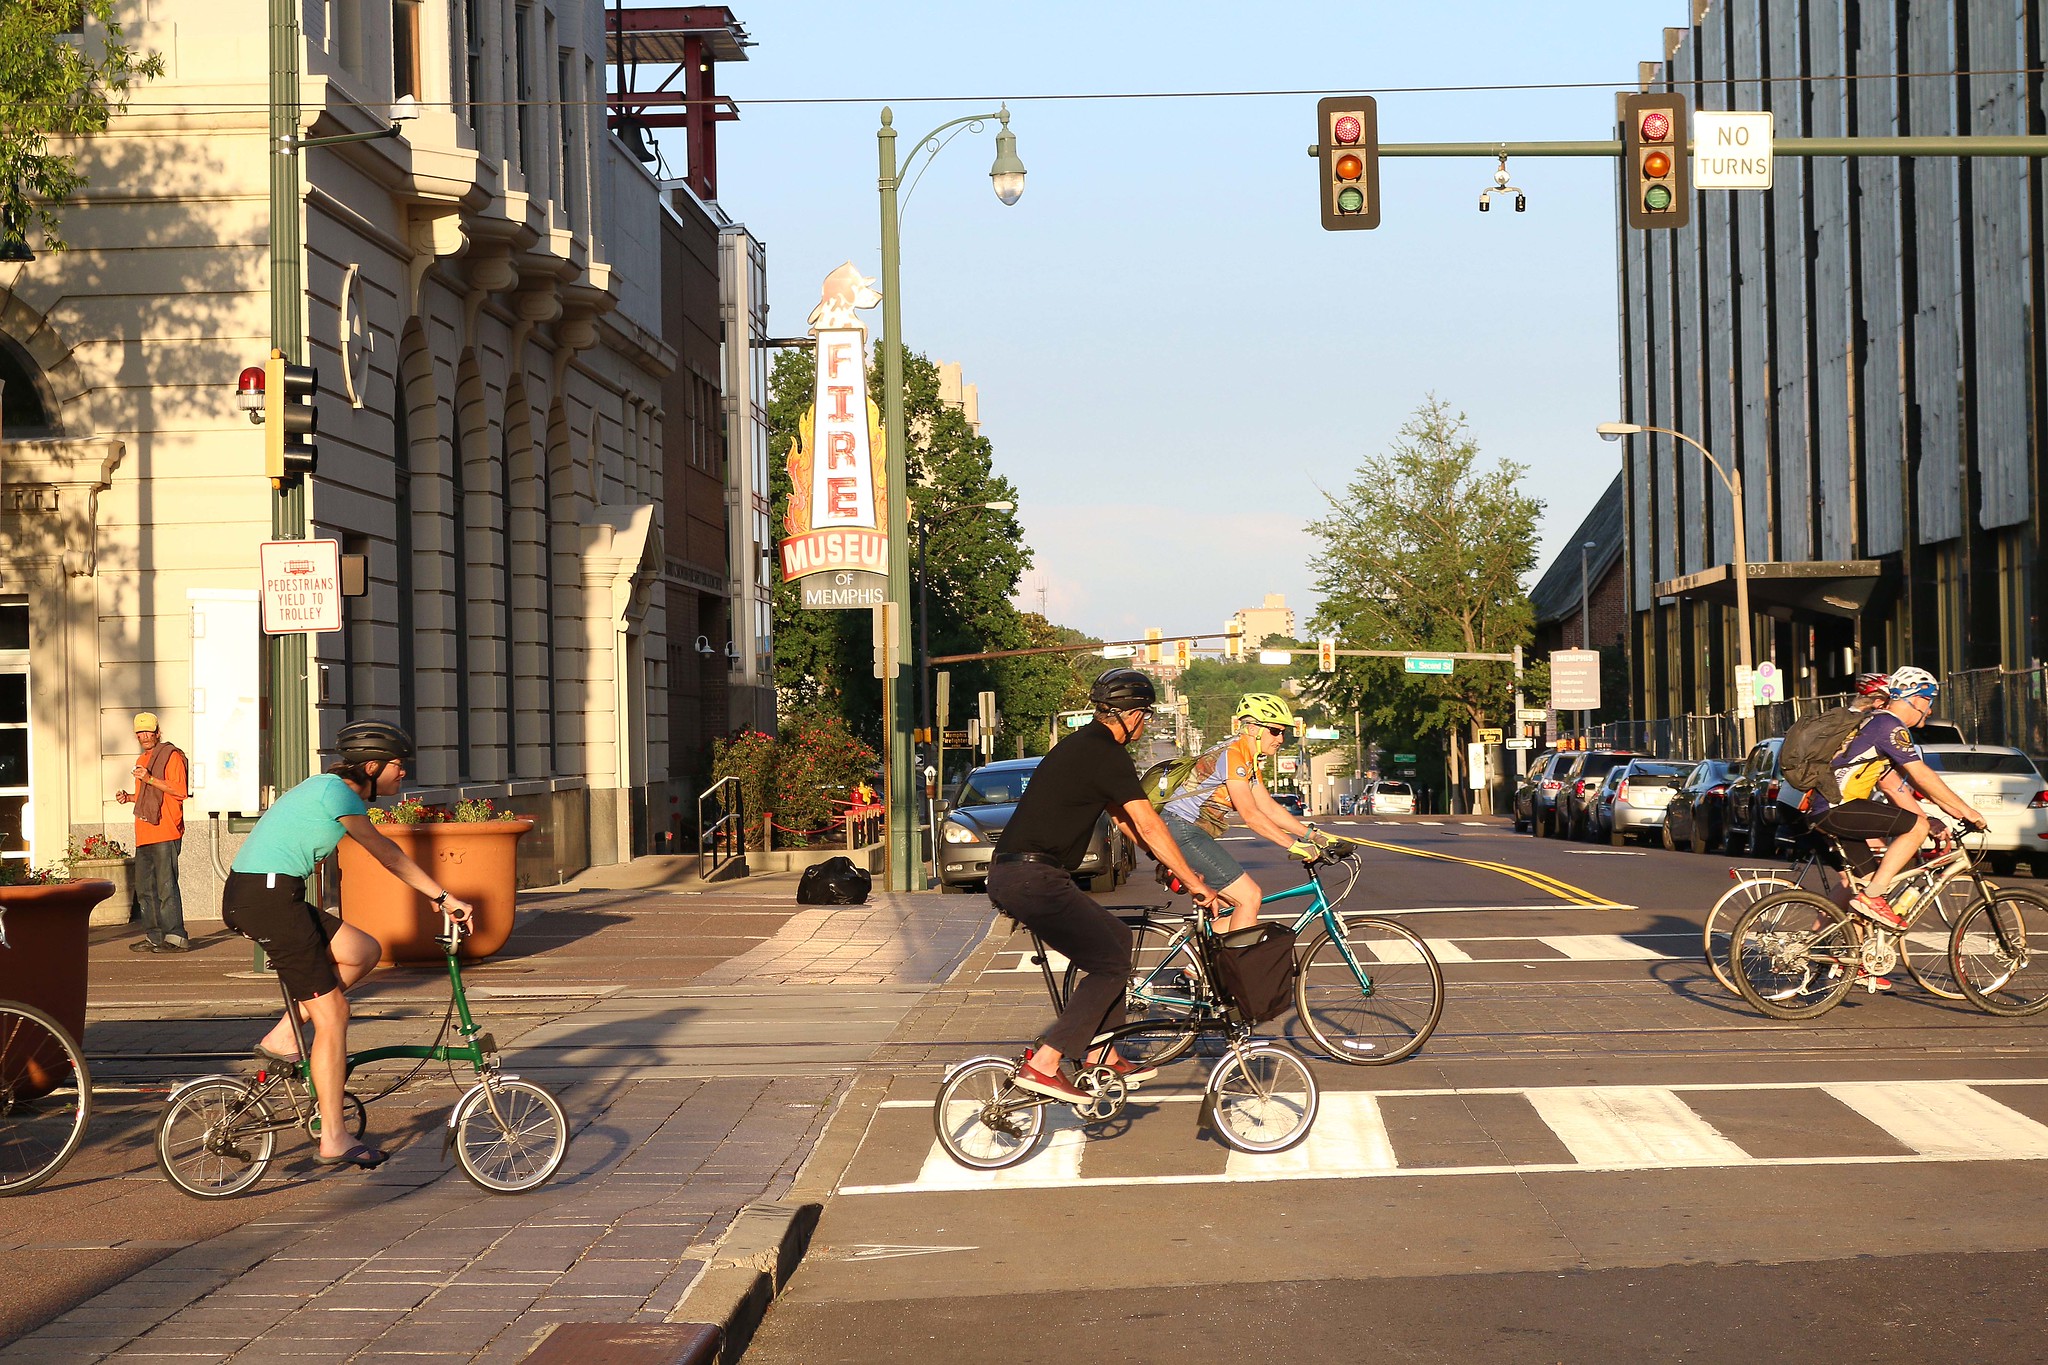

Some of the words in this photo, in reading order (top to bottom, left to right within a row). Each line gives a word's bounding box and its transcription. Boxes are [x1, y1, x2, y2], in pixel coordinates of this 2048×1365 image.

[1718, 126, 1749, 146] NO
[1700, 158, 1767, 175] TURNS
[827, 342, 858, 518] FIRE
[268, 577, 334, 592] PEDESTRIANS
[835, 573, 854, 586] OF
[277, 593, 306, 606] YIELD
[312, 592, 324, 605] TO
[806, 588, 884, 606] MEMPHIS
[280, 607, 322, 621] TROLLEY
[1418, 660, 1442, 670] Second
[1556, 654, 1594, 663] MEMPHIS
[1763, 665, 1770, 676] P
